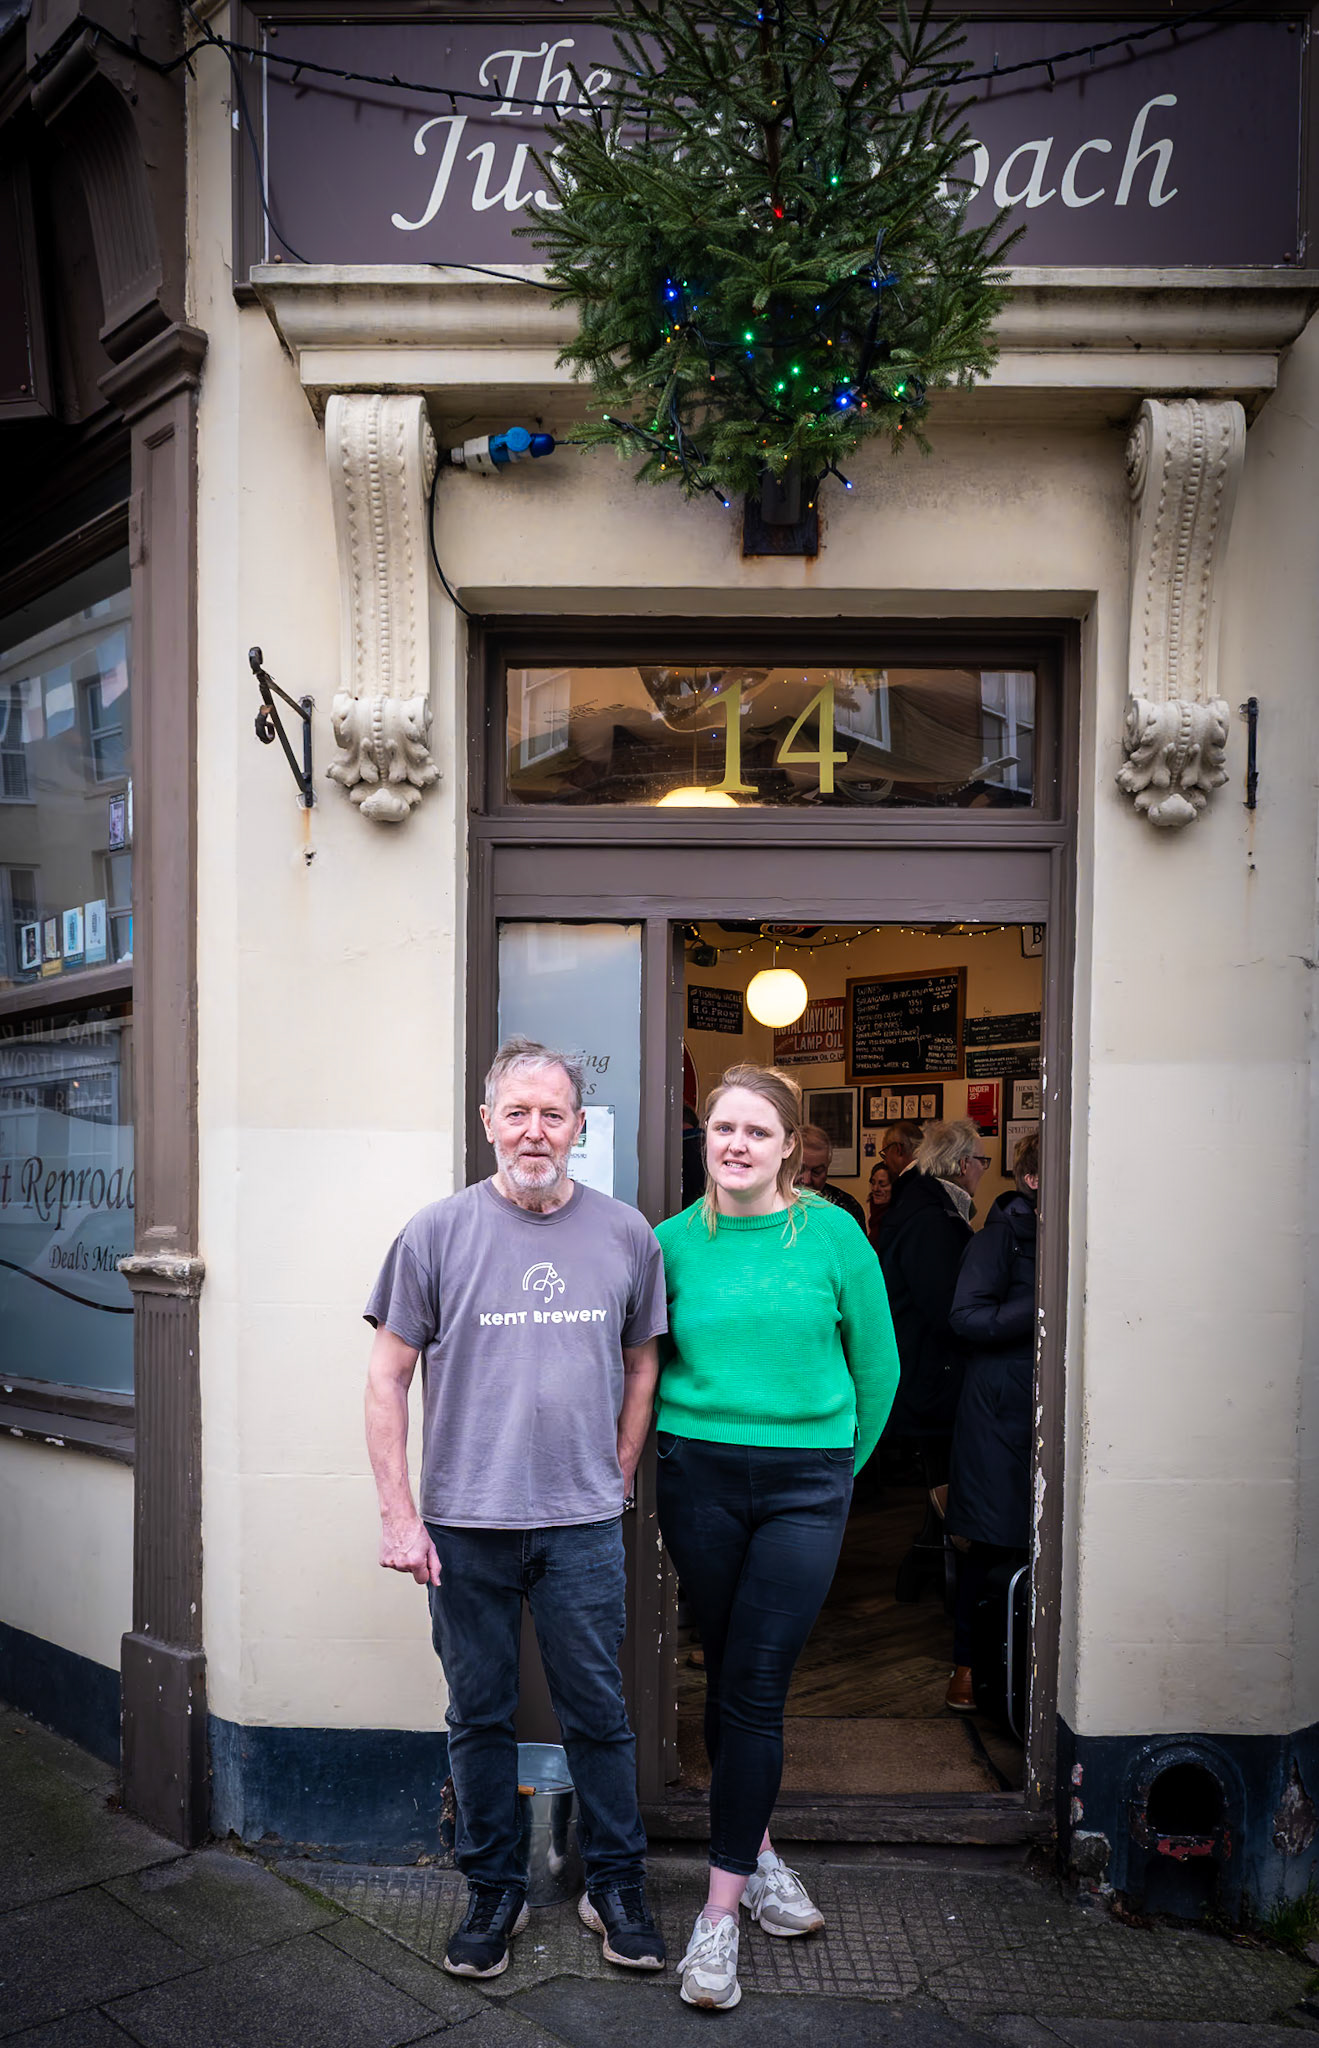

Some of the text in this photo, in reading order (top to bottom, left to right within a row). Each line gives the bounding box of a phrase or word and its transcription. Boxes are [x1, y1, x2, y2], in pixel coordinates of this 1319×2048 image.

[478, 38, 612, 117] The
[704, 679, 848, 794] 14
[23, 1017, 61, 1043] HILL
[68, 1019, 111, 1047] GATE
[803, 1006, 845, 1034] DAYLIGHT
[794, 1035, 823, 1051] LAMP
[825, 1032, 844, 1049] OIL
[969, 1086, 990, 1094] UNDER
[22, 1156, 135, 1231] Reproac
[50, 1241, 89, 1270] Deal's
